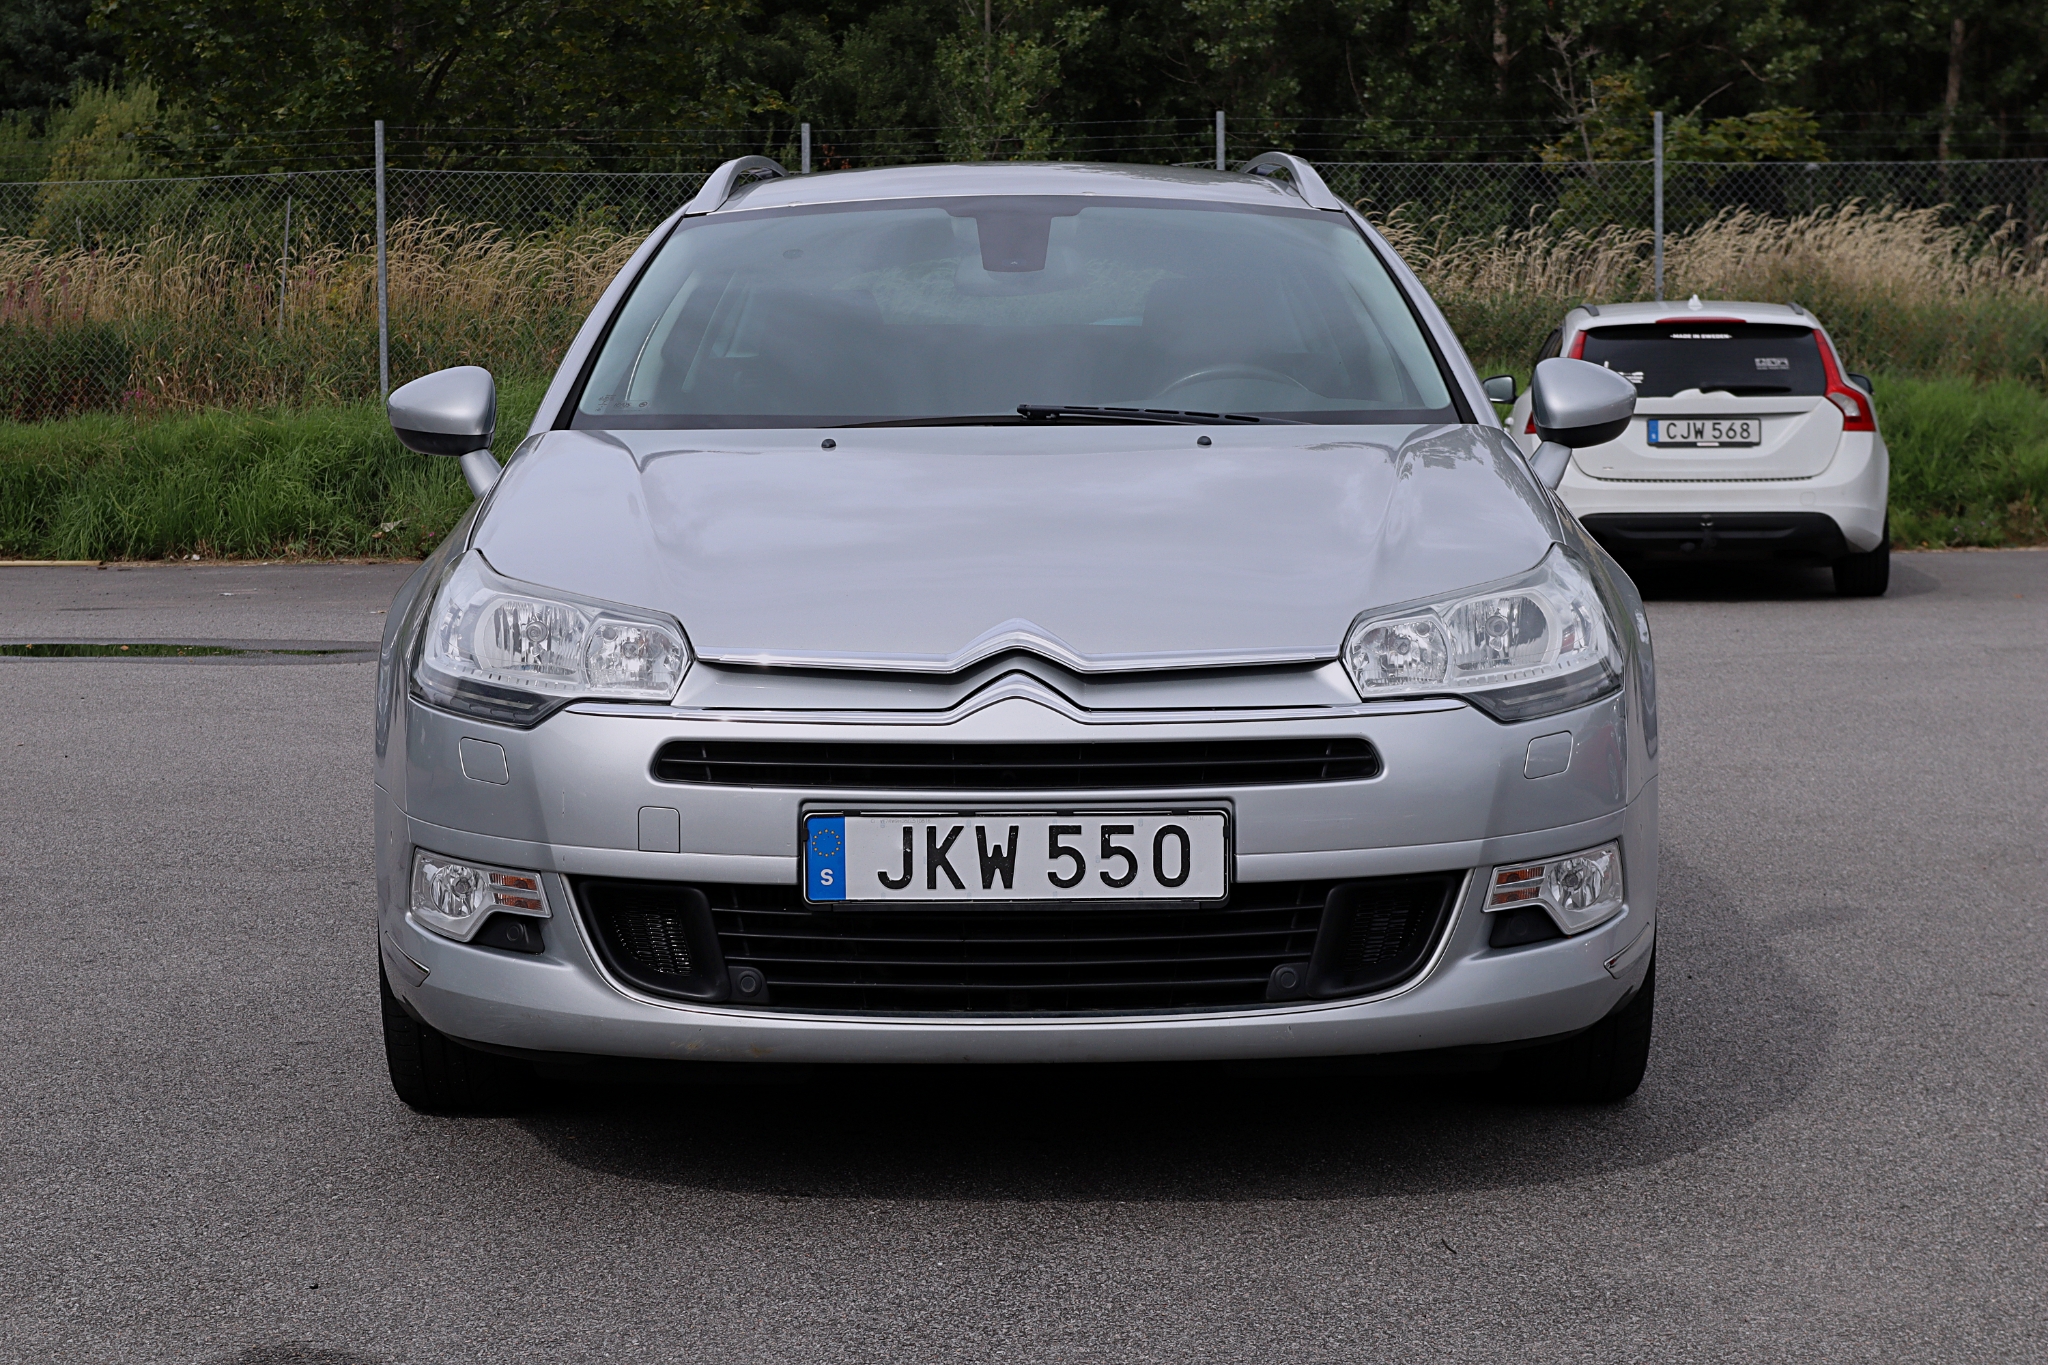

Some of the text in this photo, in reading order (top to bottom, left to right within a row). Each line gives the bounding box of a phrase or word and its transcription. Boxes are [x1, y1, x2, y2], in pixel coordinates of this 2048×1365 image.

[1666, 422, 1751, 440] CJW 568
[877, 824, 1191, 890] JKW 550
[820, 868, 833, 886] S
